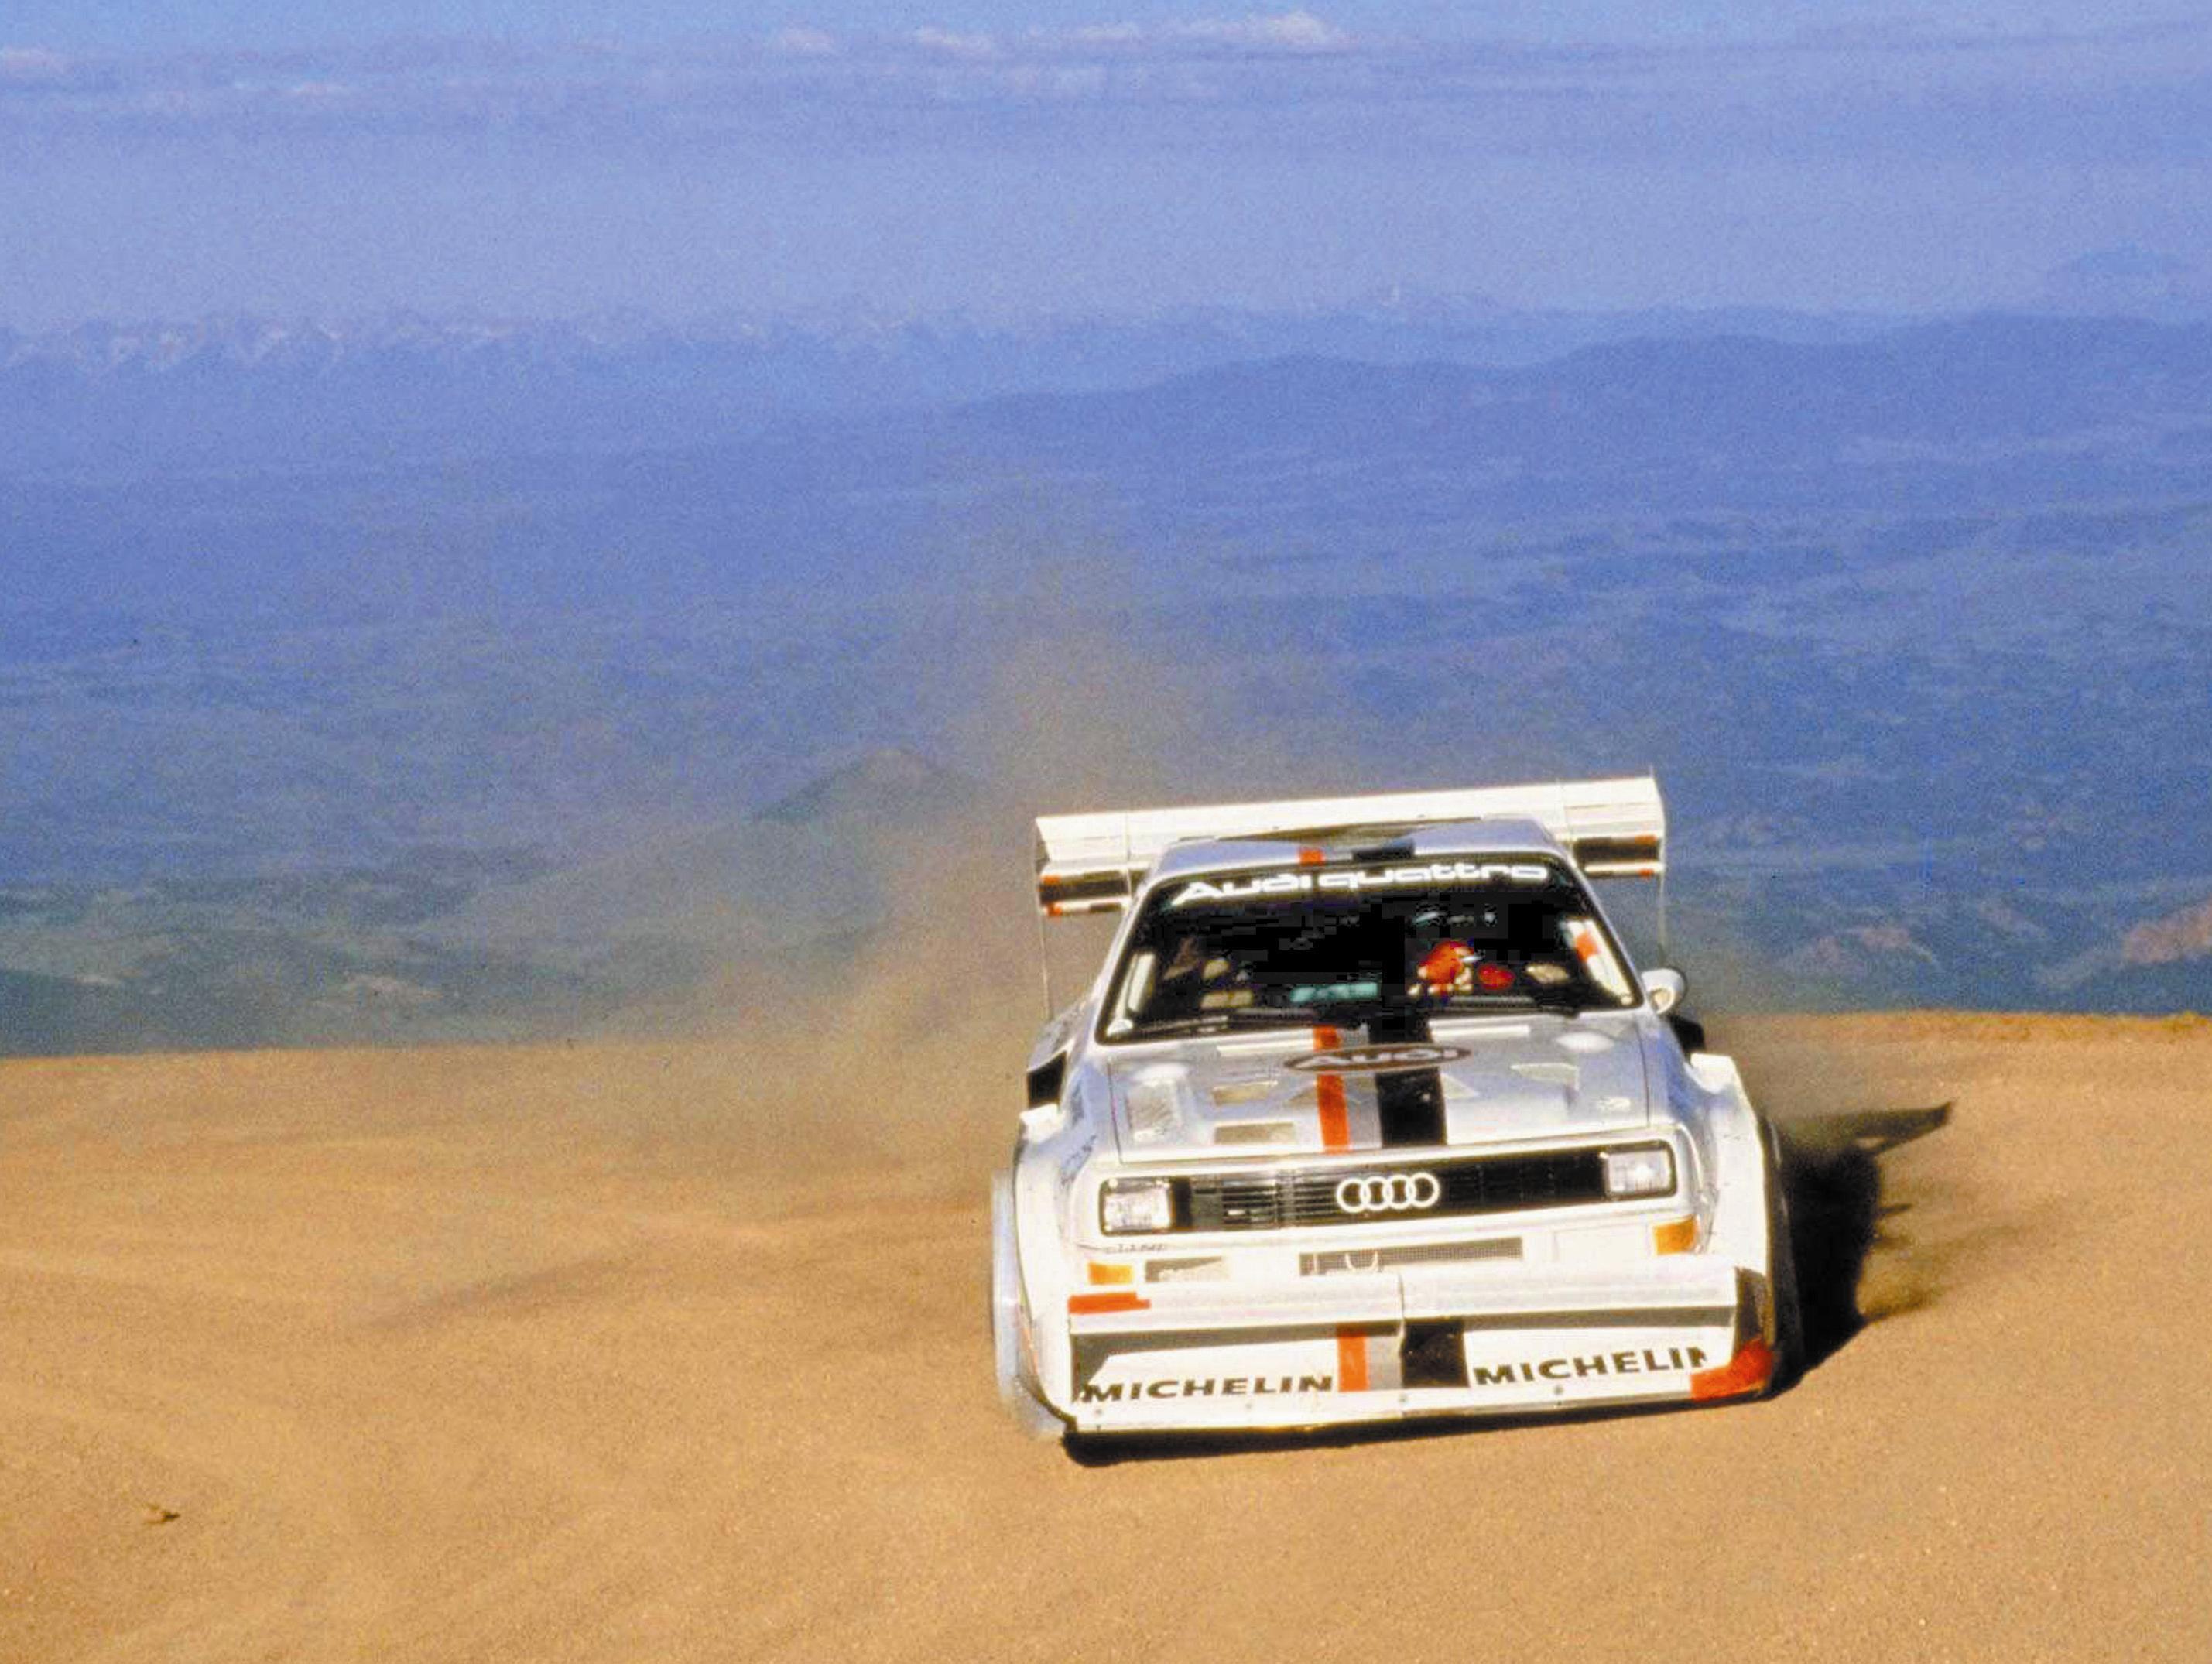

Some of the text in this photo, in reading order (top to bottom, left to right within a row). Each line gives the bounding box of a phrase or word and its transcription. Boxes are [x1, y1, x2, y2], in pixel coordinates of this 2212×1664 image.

[1171, 862, 1547, 905] Audi quattro
[1081, 1375, 1334, 1402] MICHELIN
